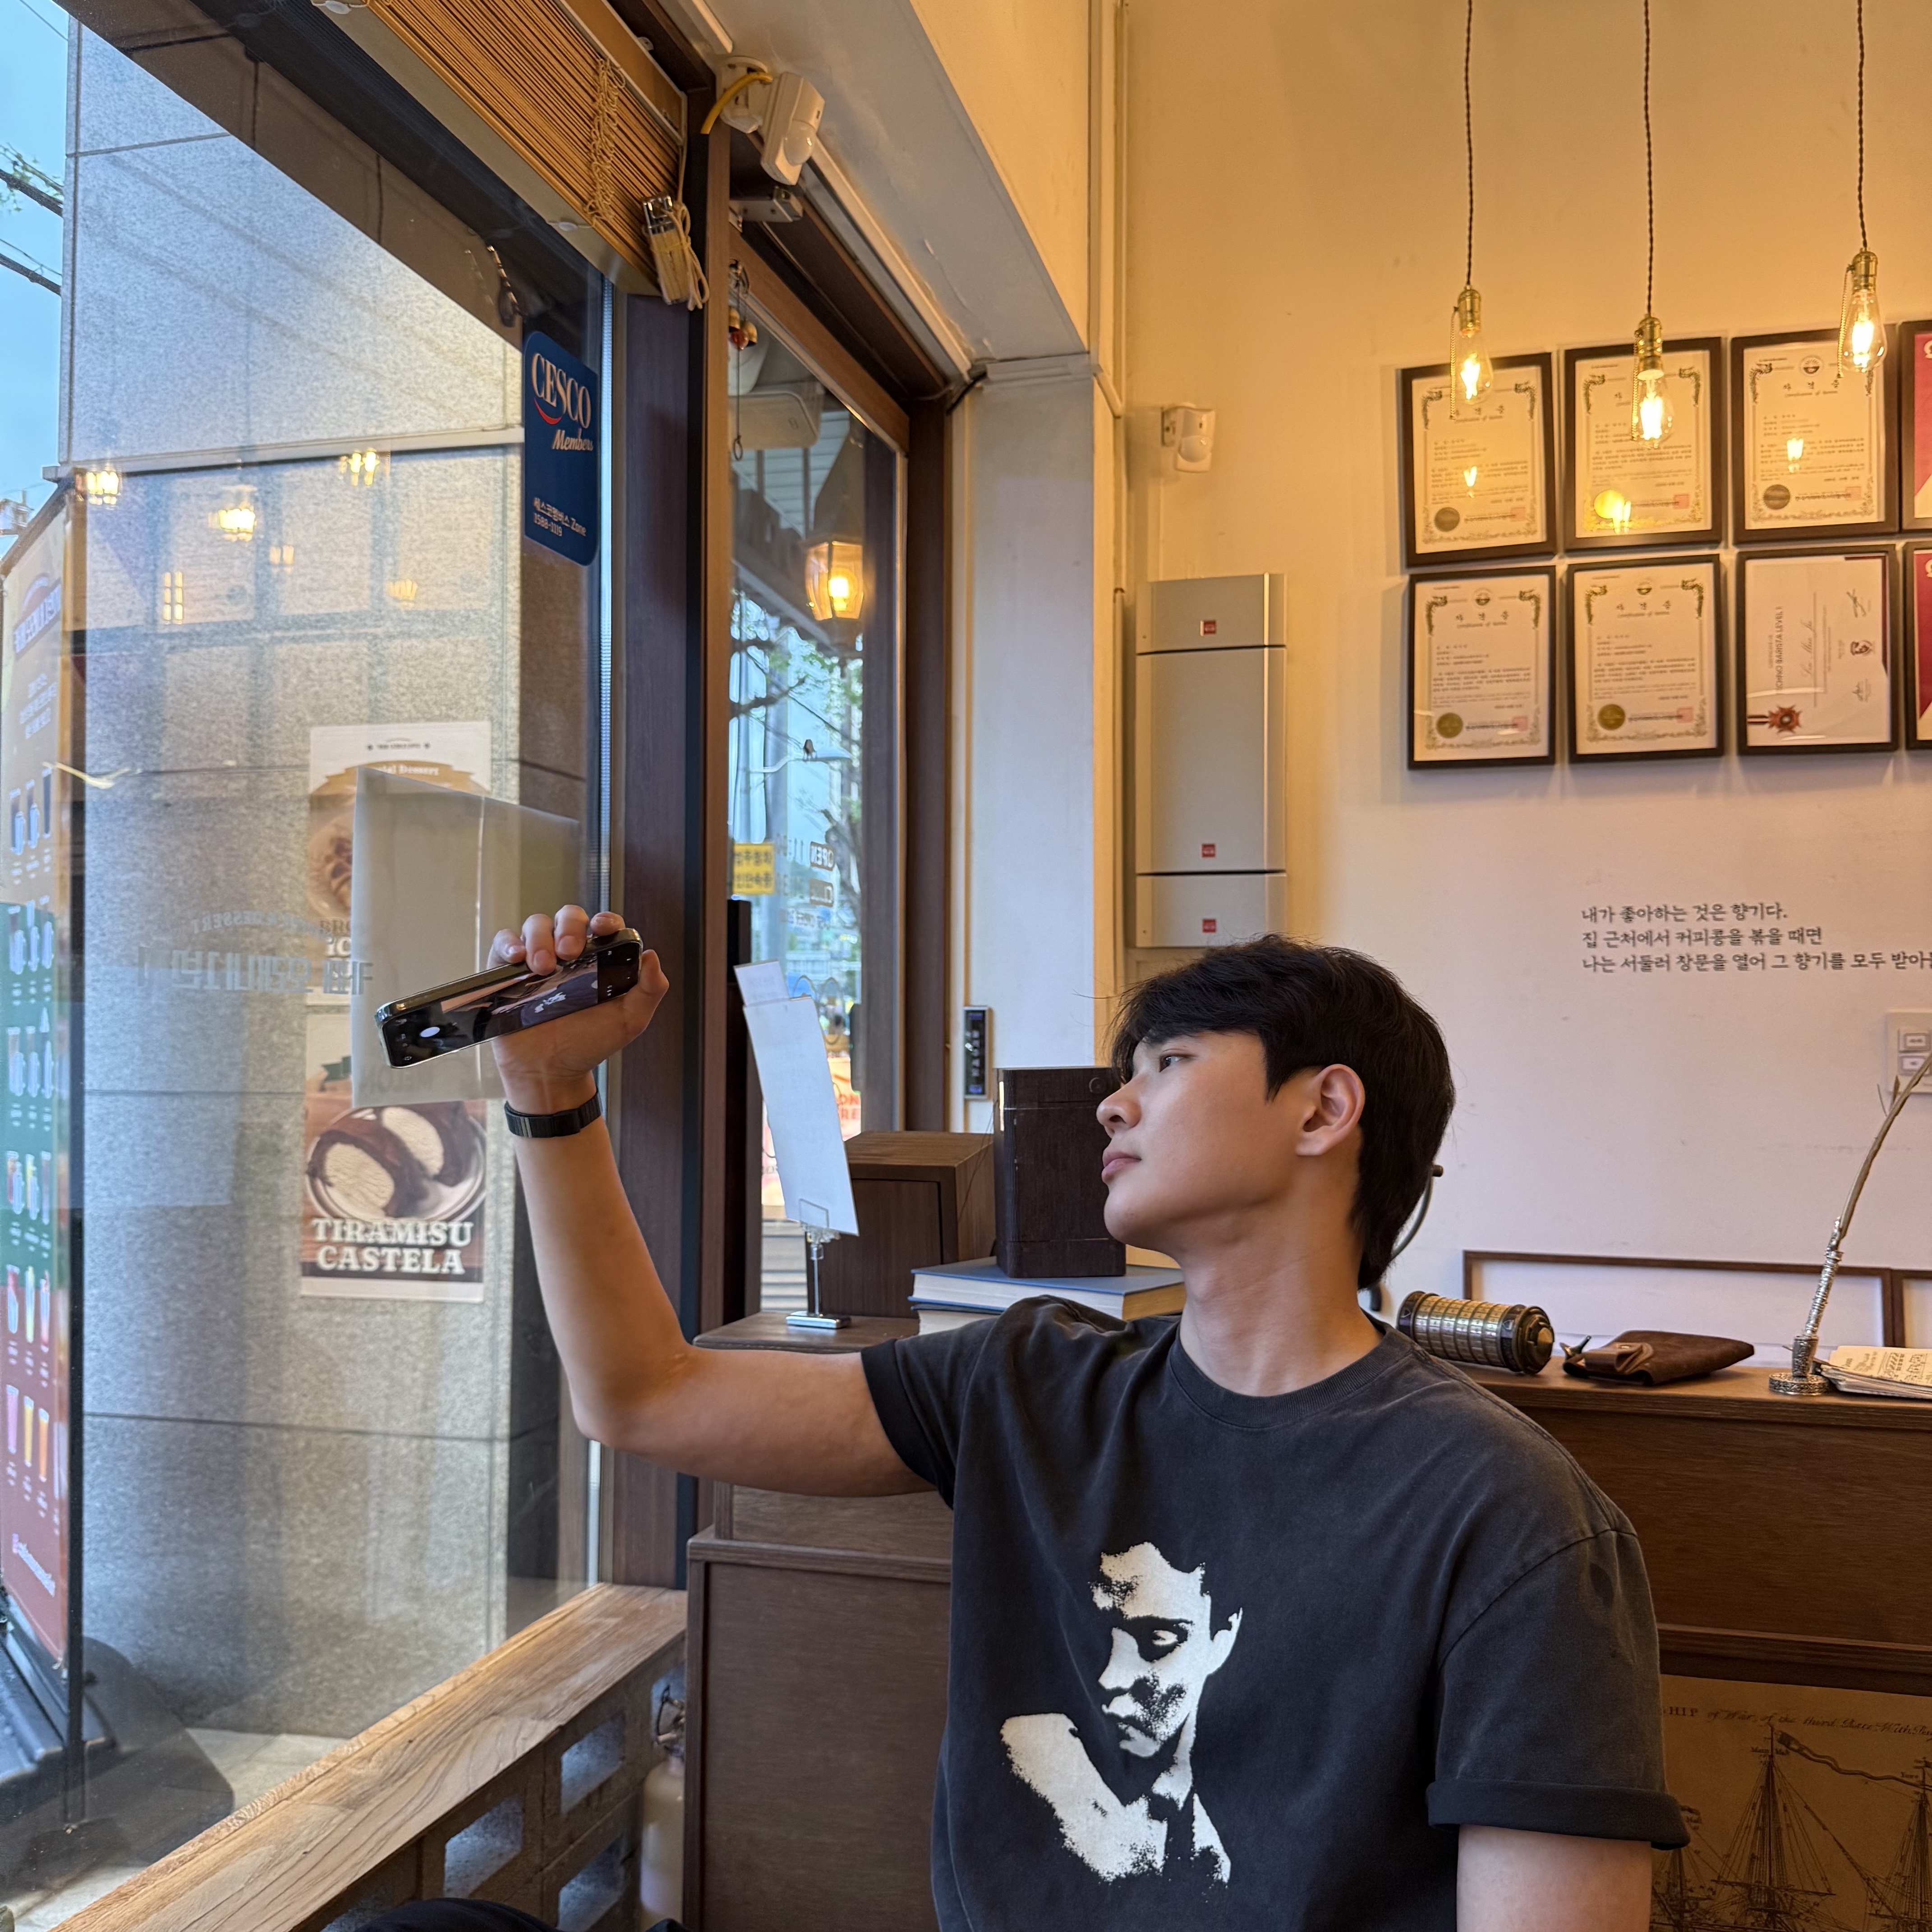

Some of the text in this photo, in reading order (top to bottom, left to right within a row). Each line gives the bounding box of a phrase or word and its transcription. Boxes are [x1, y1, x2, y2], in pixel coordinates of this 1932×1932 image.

[532, 353, 591, 428] CESCO
[552, 428, 593, 451] Members
[570, 517, 587, 537] Zone
[1582, 902, 1788, 923] 내가 좋아하는 것은 향기다.
[1582, 927, 1822, 948] 집 근처에서 커피콩을 볶을 때면
[1582, 951, 1932, 973] 나는 서둘러 창문을 열어 그 향기를 모두 받아
[311, 1218, 474, 1247] TIRAMISU
[317, 1245, 465, 1275] CASTELA
